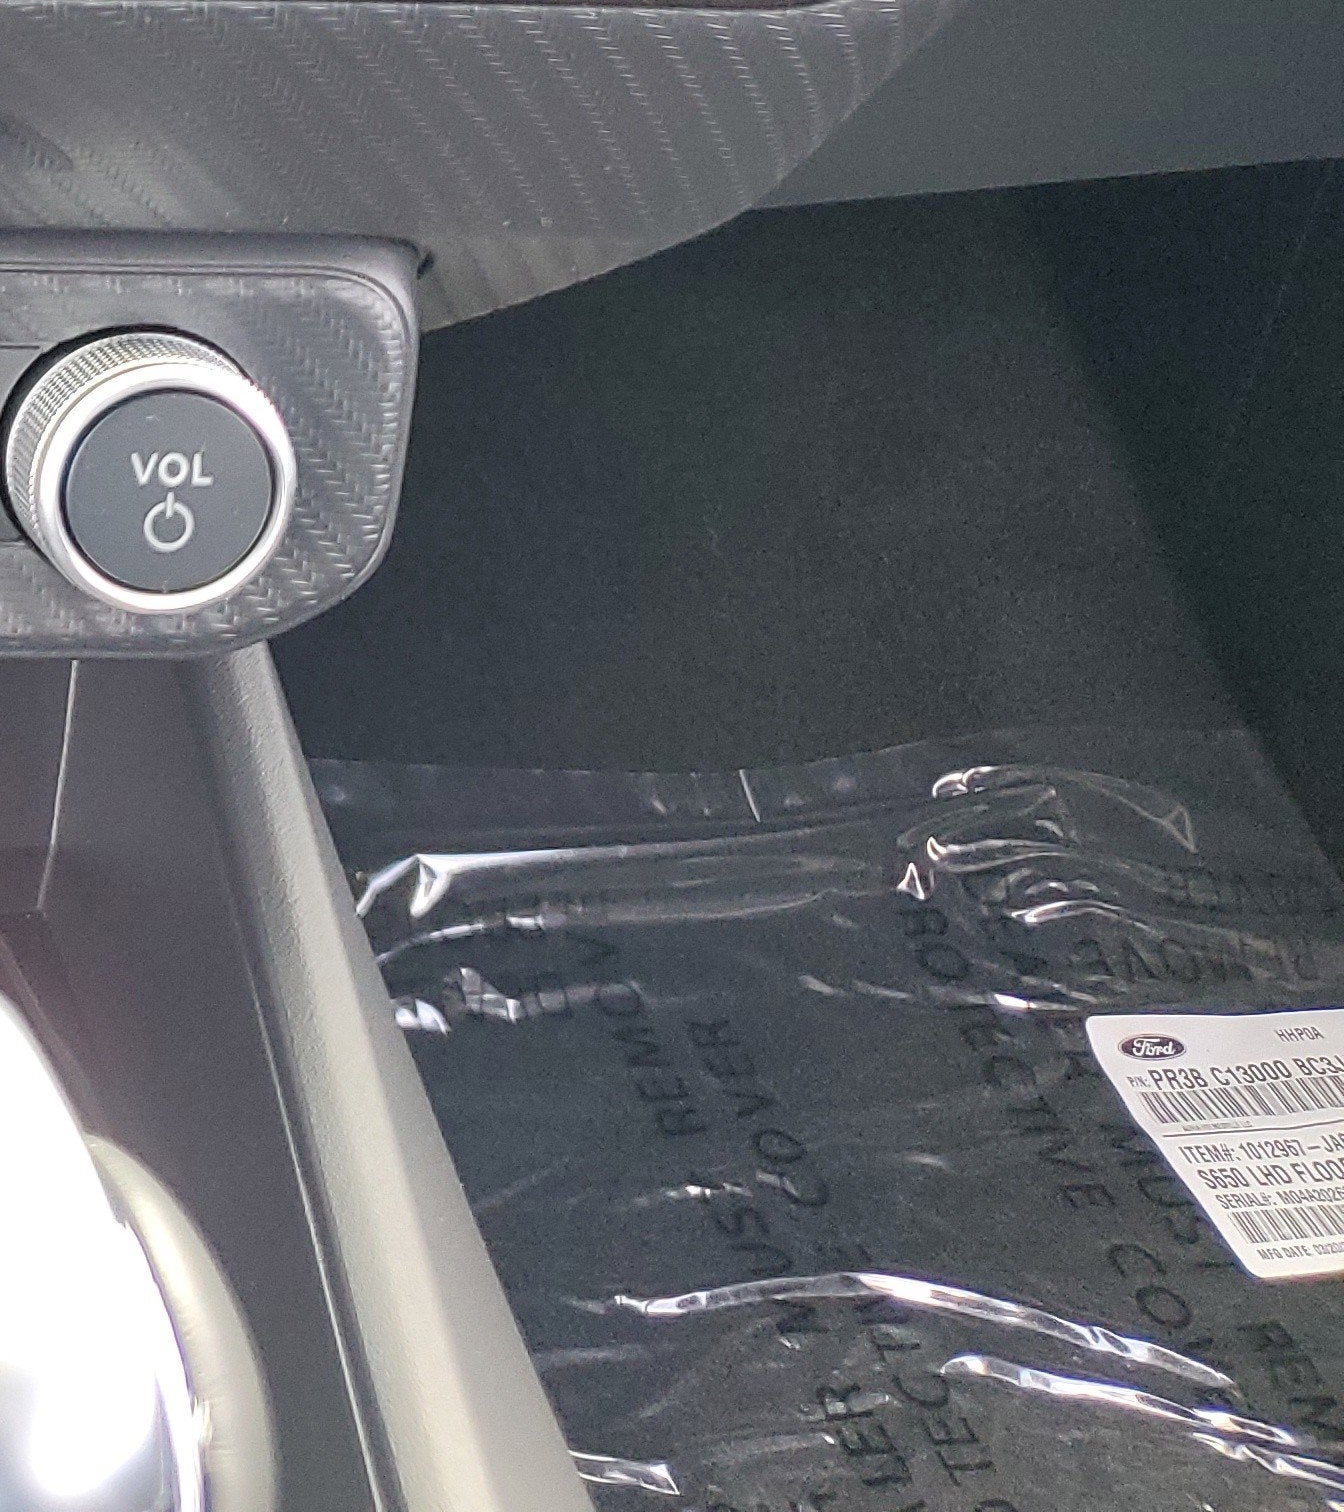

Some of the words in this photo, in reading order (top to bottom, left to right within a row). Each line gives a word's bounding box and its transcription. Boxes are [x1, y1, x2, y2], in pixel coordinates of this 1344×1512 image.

[131, 452, 213, 487] VOL
[1148, 1068, 1209, 1091] PR3B
[1210, 1059, 1293, 1087] C13000
[1178, 1143, 1242, 1164] ITEM#:
[1197, 1167, 1250, 1189] S650
[1246, 1164, 1293, 1187] LHD
